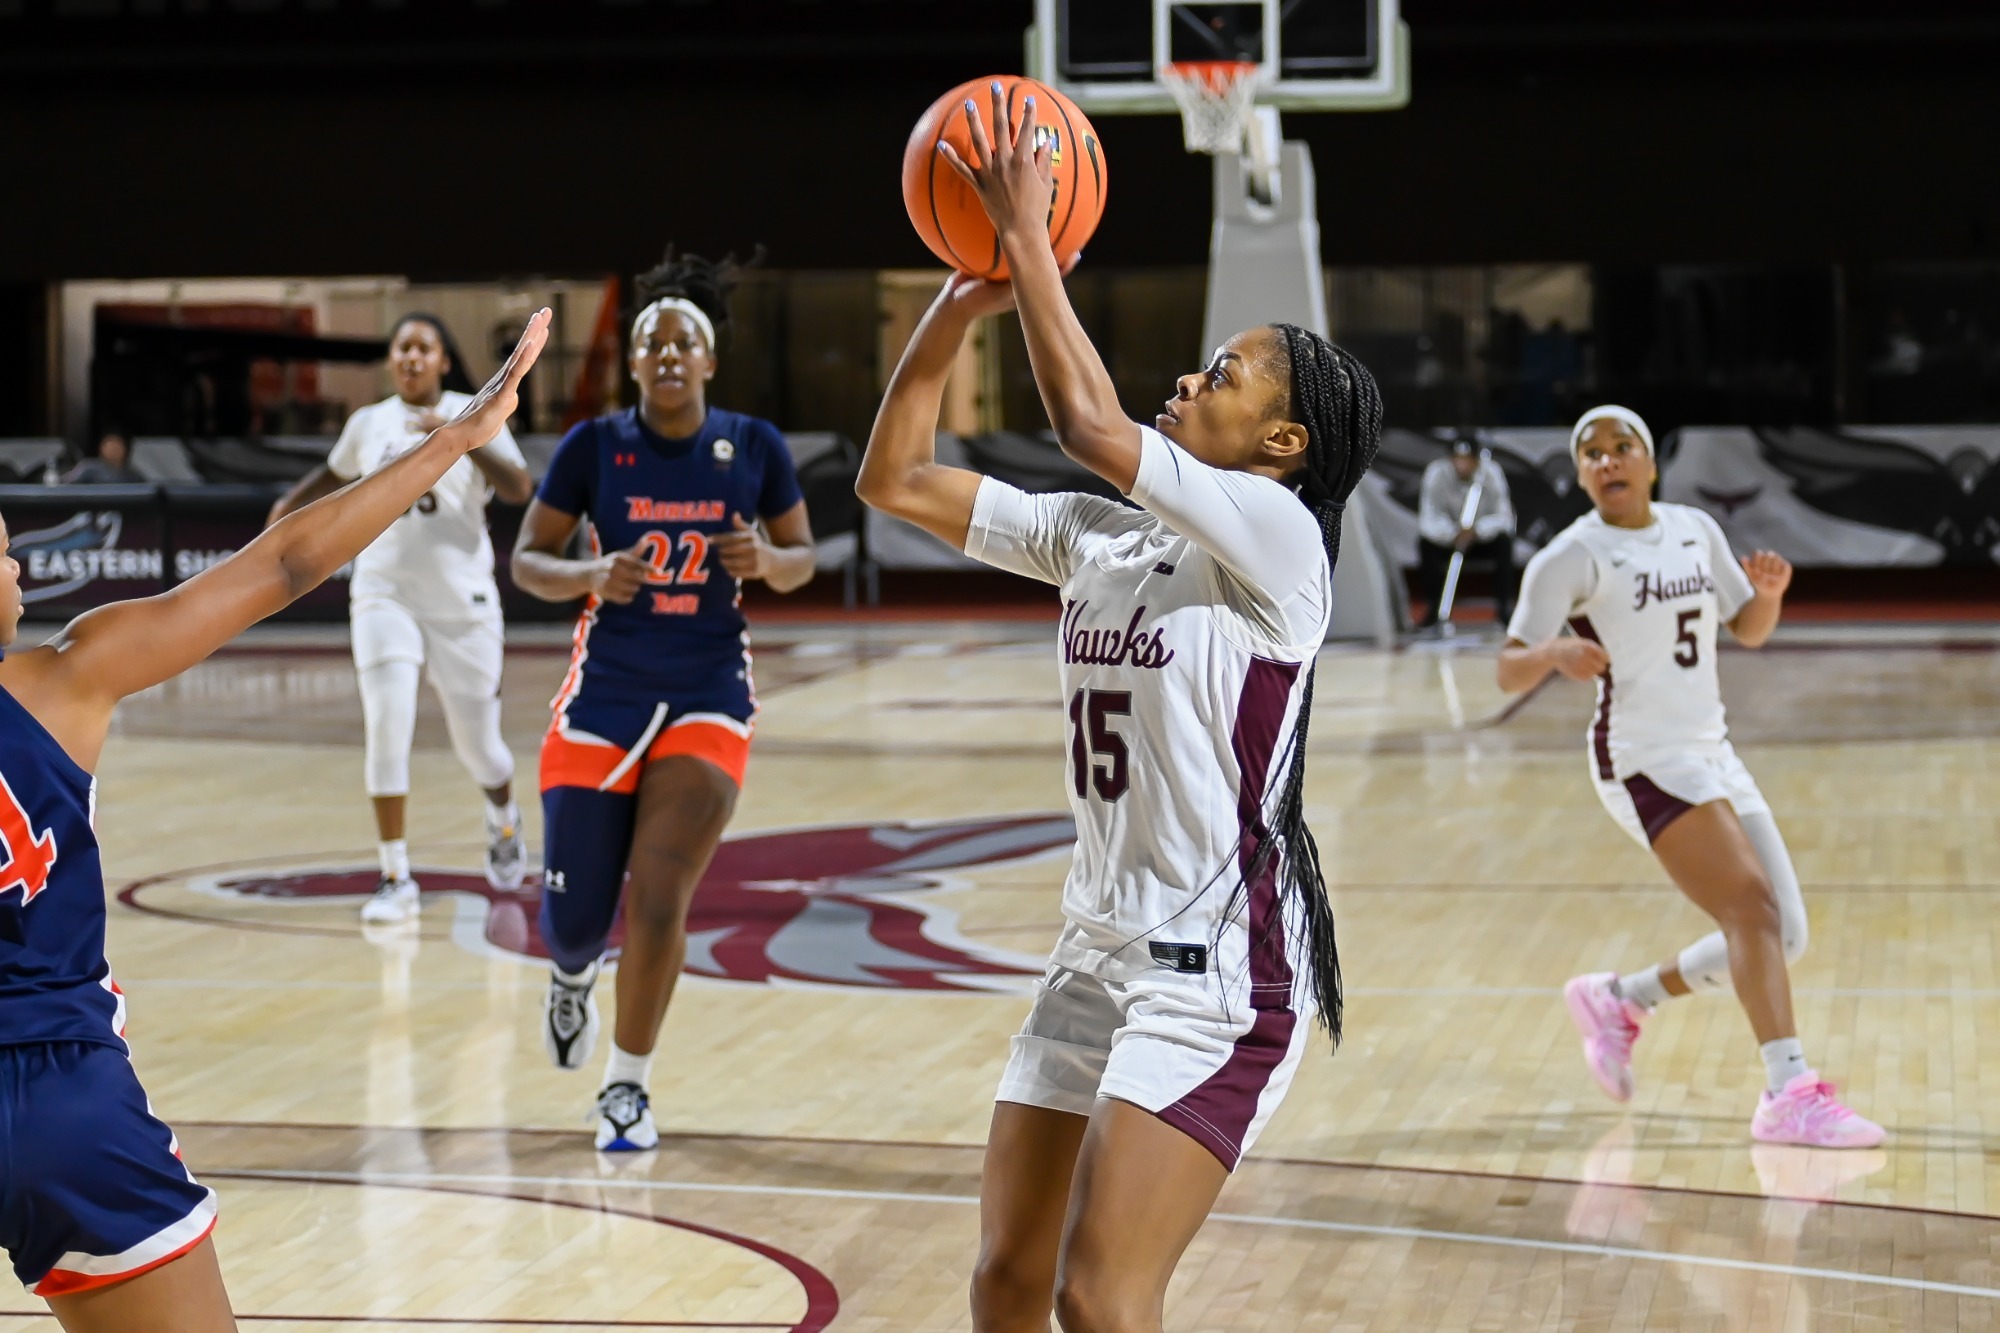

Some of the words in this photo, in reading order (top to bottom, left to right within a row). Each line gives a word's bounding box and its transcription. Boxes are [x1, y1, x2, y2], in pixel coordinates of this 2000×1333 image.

[28, 549, 163, 579] EASTERN
[644, 529, 710, 586] 22
[1674, 606, 1702, 669] 5
[1069, 687, 1132, 804] 15
[1187, 952, 1197, 965] S
